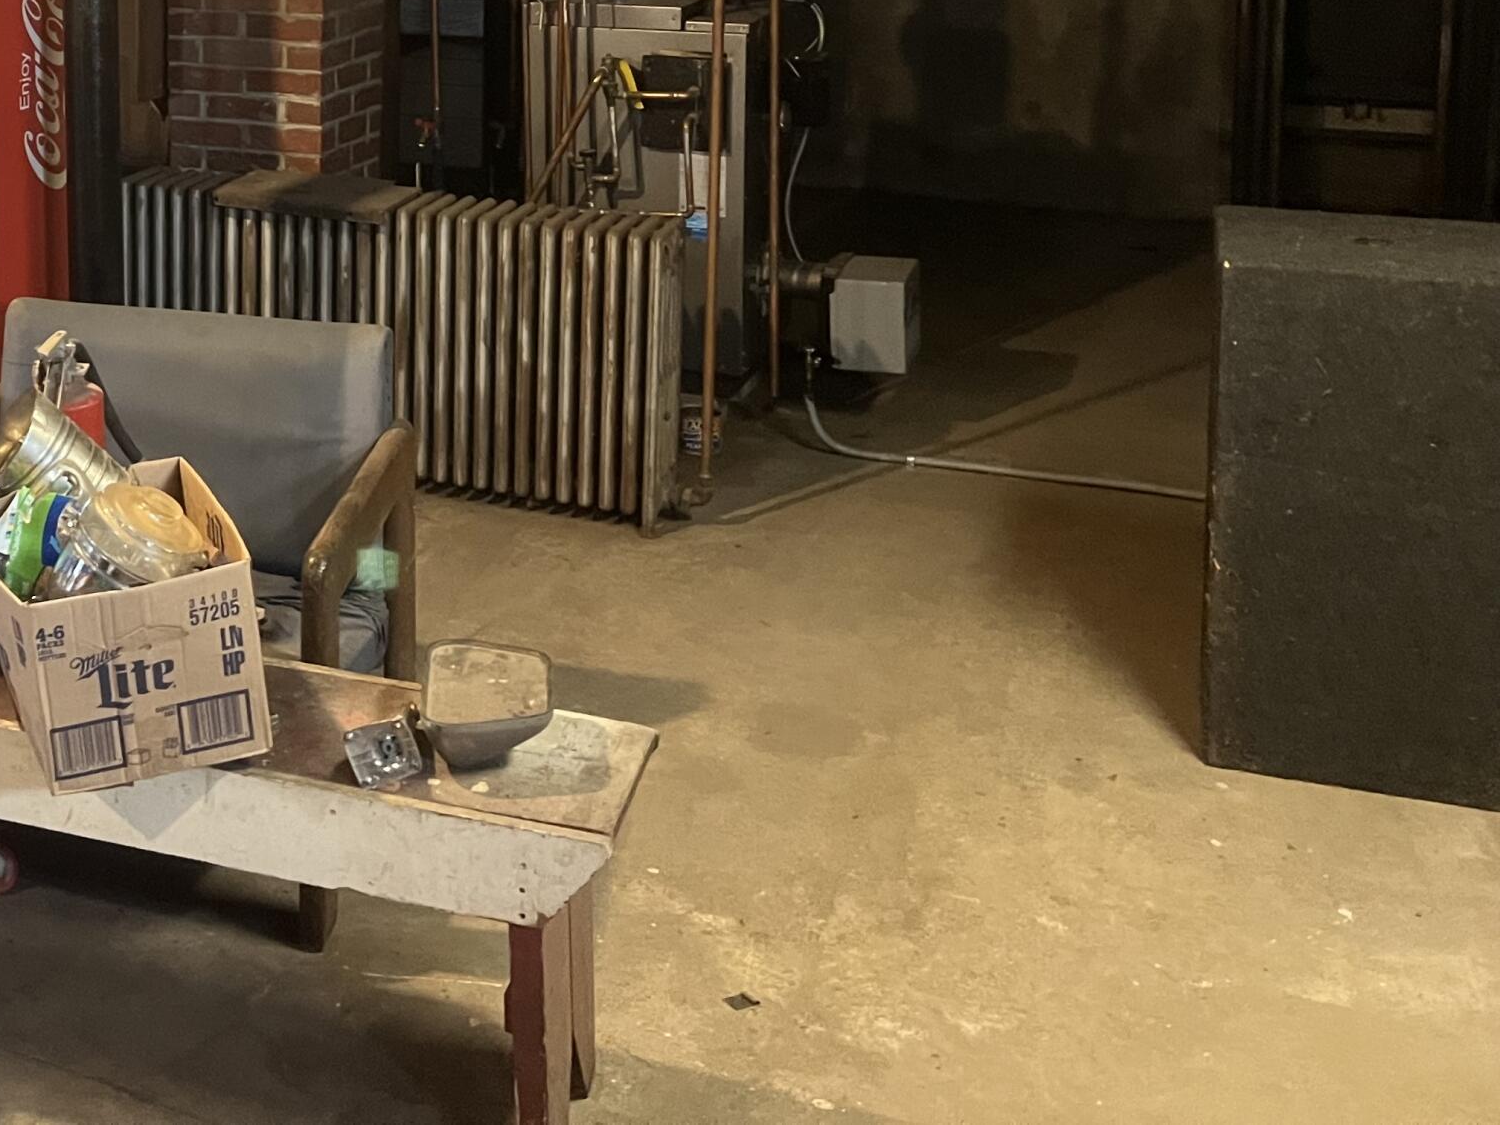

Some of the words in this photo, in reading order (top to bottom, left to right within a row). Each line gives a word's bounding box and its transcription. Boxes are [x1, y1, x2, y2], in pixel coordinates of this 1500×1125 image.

[19, 52, 32, 111] Enjoy
[189, 599, 240, 626] 57205
[36, 625, 65, 643] 4-6
[220, 625, 243, 651] LN
[69, 646, 124, 679] Miller
[222, 650, 245, 676] HP
[96, 659, 176, 709] Lite
